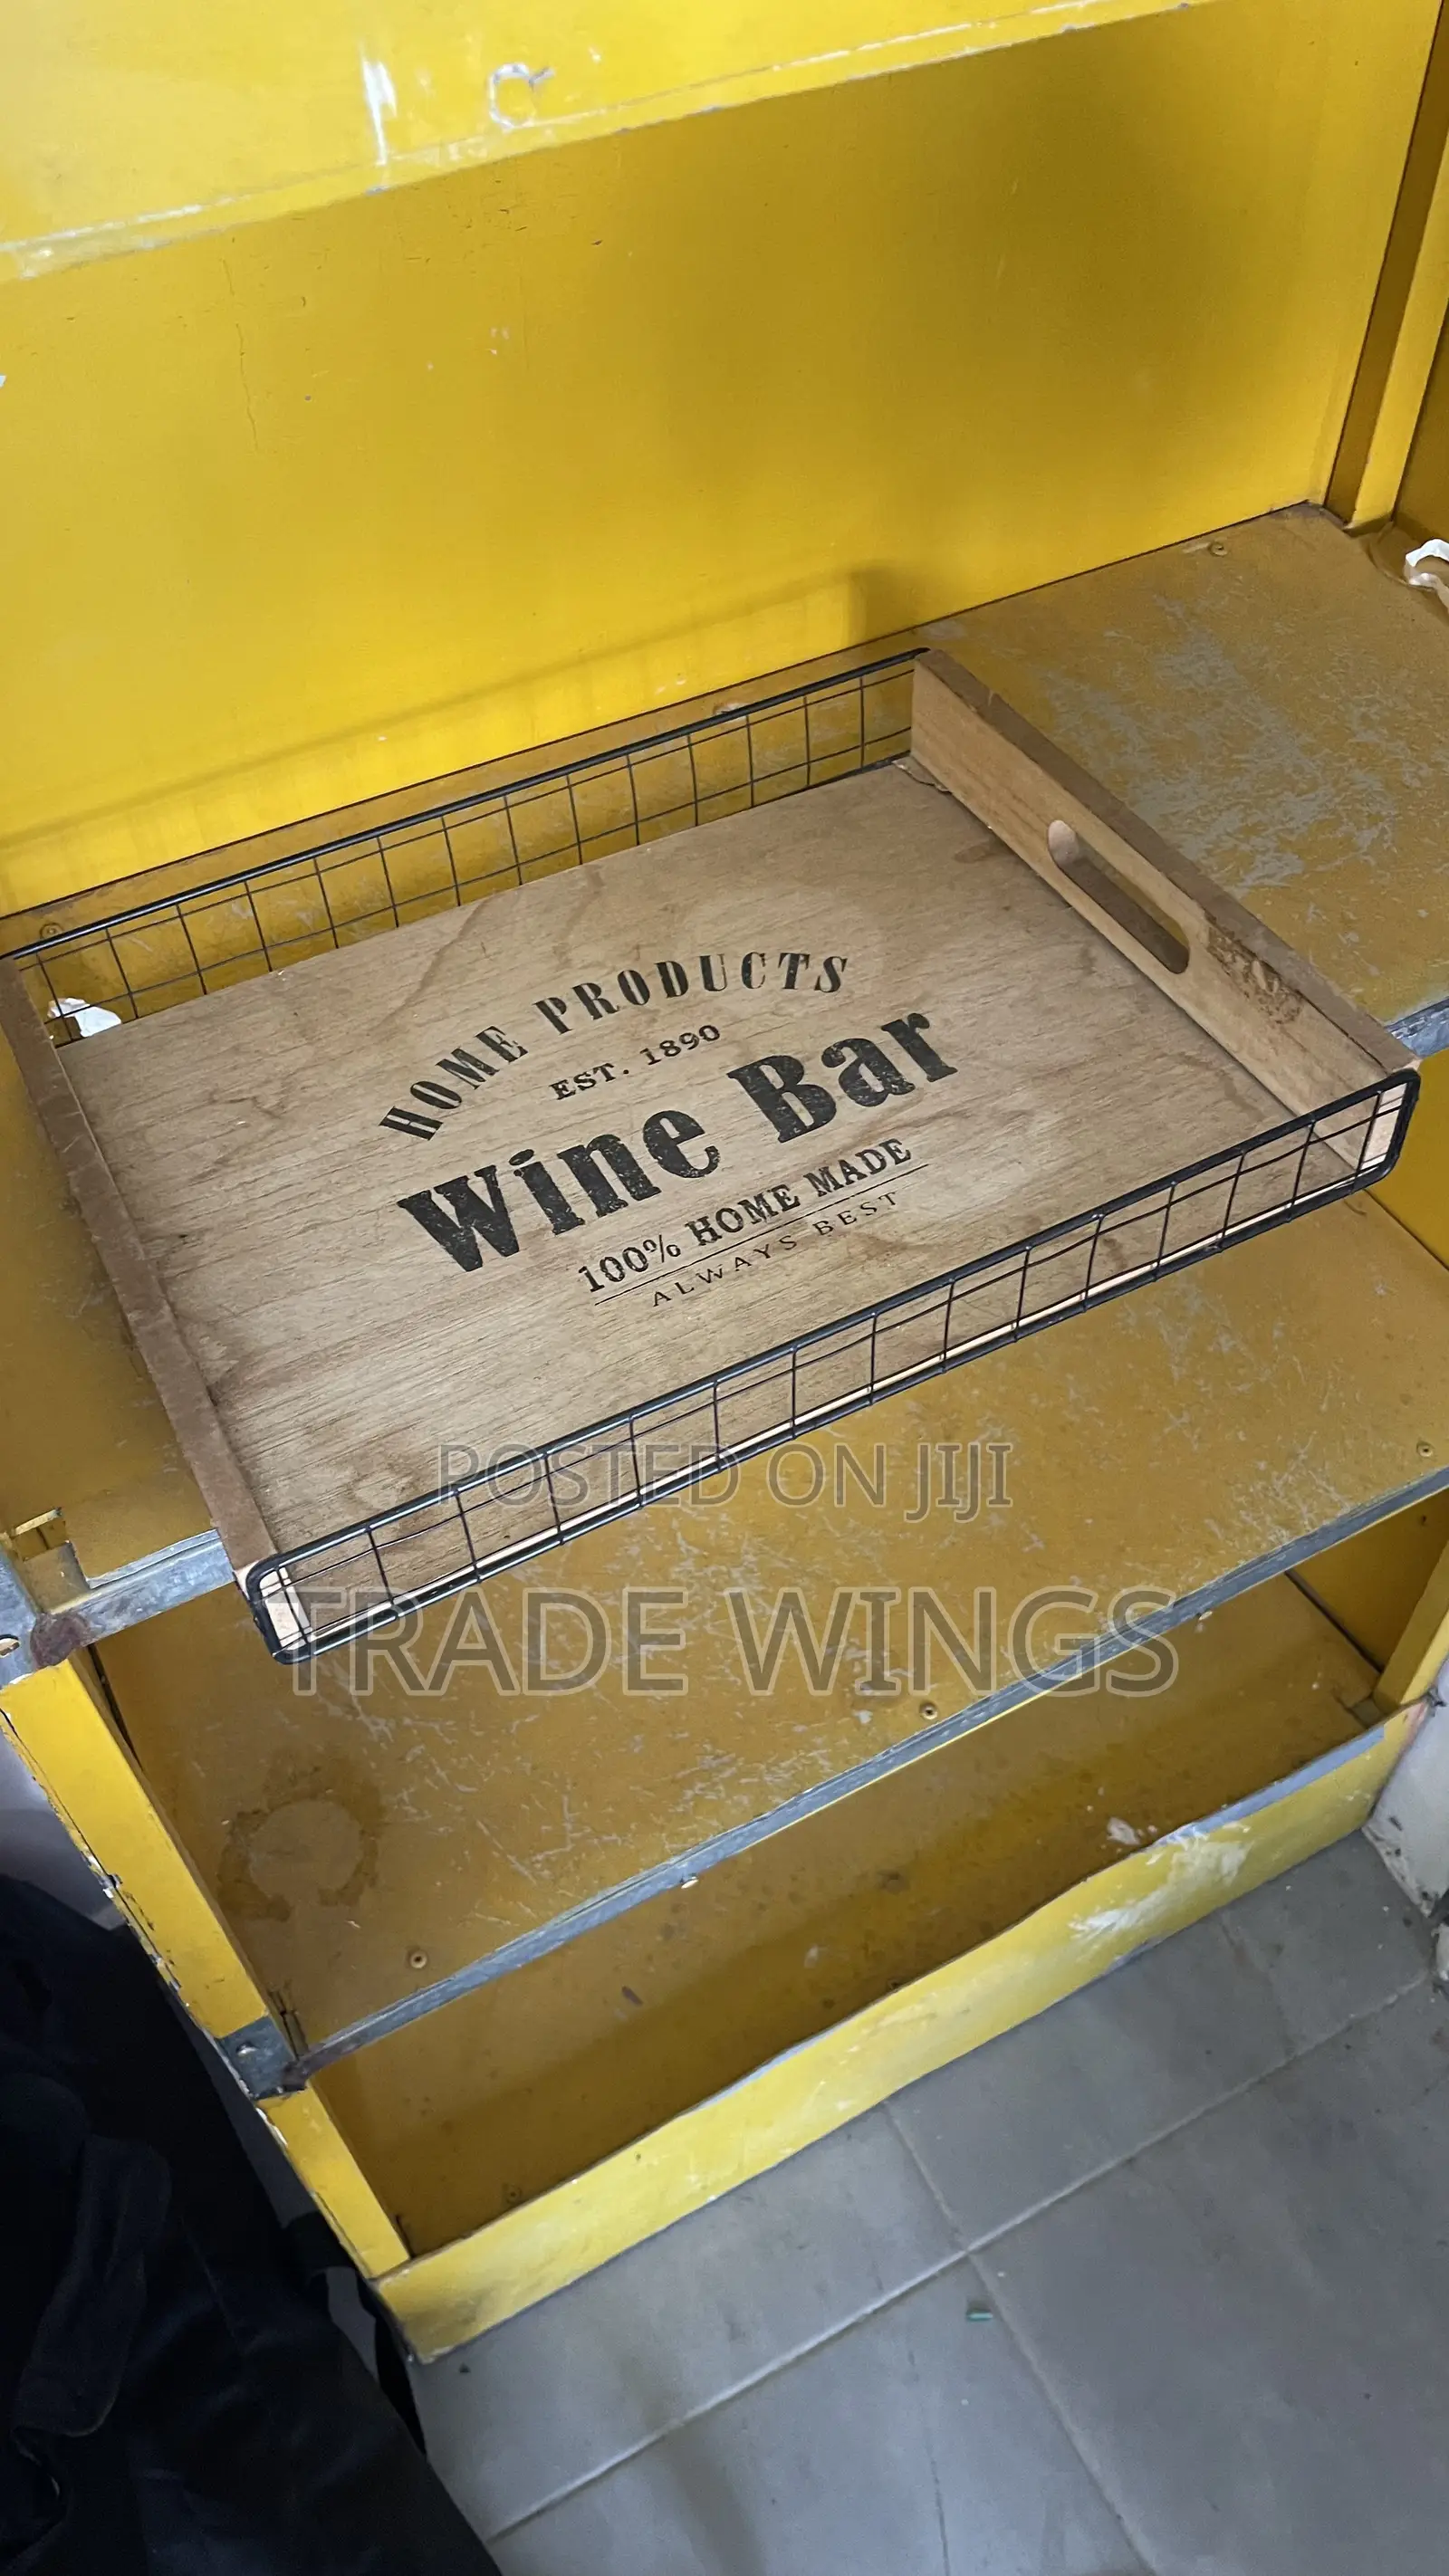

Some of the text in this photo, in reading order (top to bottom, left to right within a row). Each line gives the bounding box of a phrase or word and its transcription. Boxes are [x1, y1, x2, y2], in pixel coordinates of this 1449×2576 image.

[379, 952, 848, 1140] HOME PRODUCTS
[550, 1025, 721, 1100] EST. 1890
[397, 1012, 959, 1272] Wine Bar
[578, 1138, 910, 1293] 100% HOME MADE
[653, 1191, 902, 1306] ALWAYS BEST
